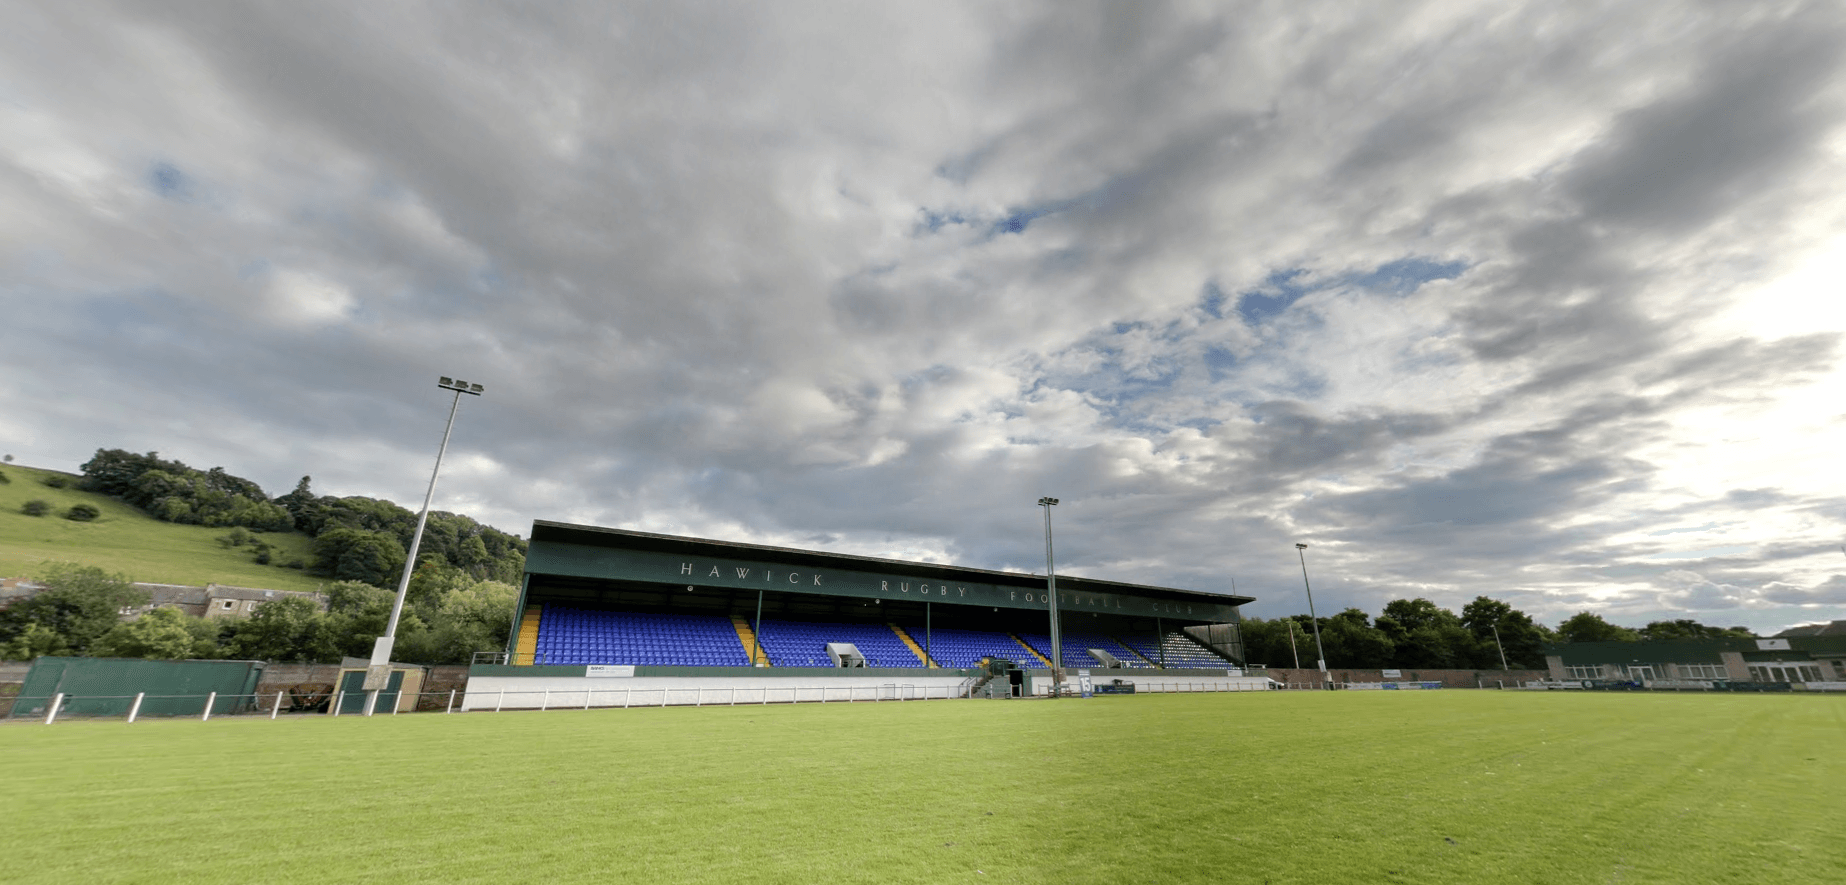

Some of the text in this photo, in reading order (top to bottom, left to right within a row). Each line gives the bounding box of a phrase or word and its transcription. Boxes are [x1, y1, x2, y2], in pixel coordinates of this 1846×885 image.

[681, 563, 1192, 615] HAWICK RUGBY FOOTBALL CLUB
